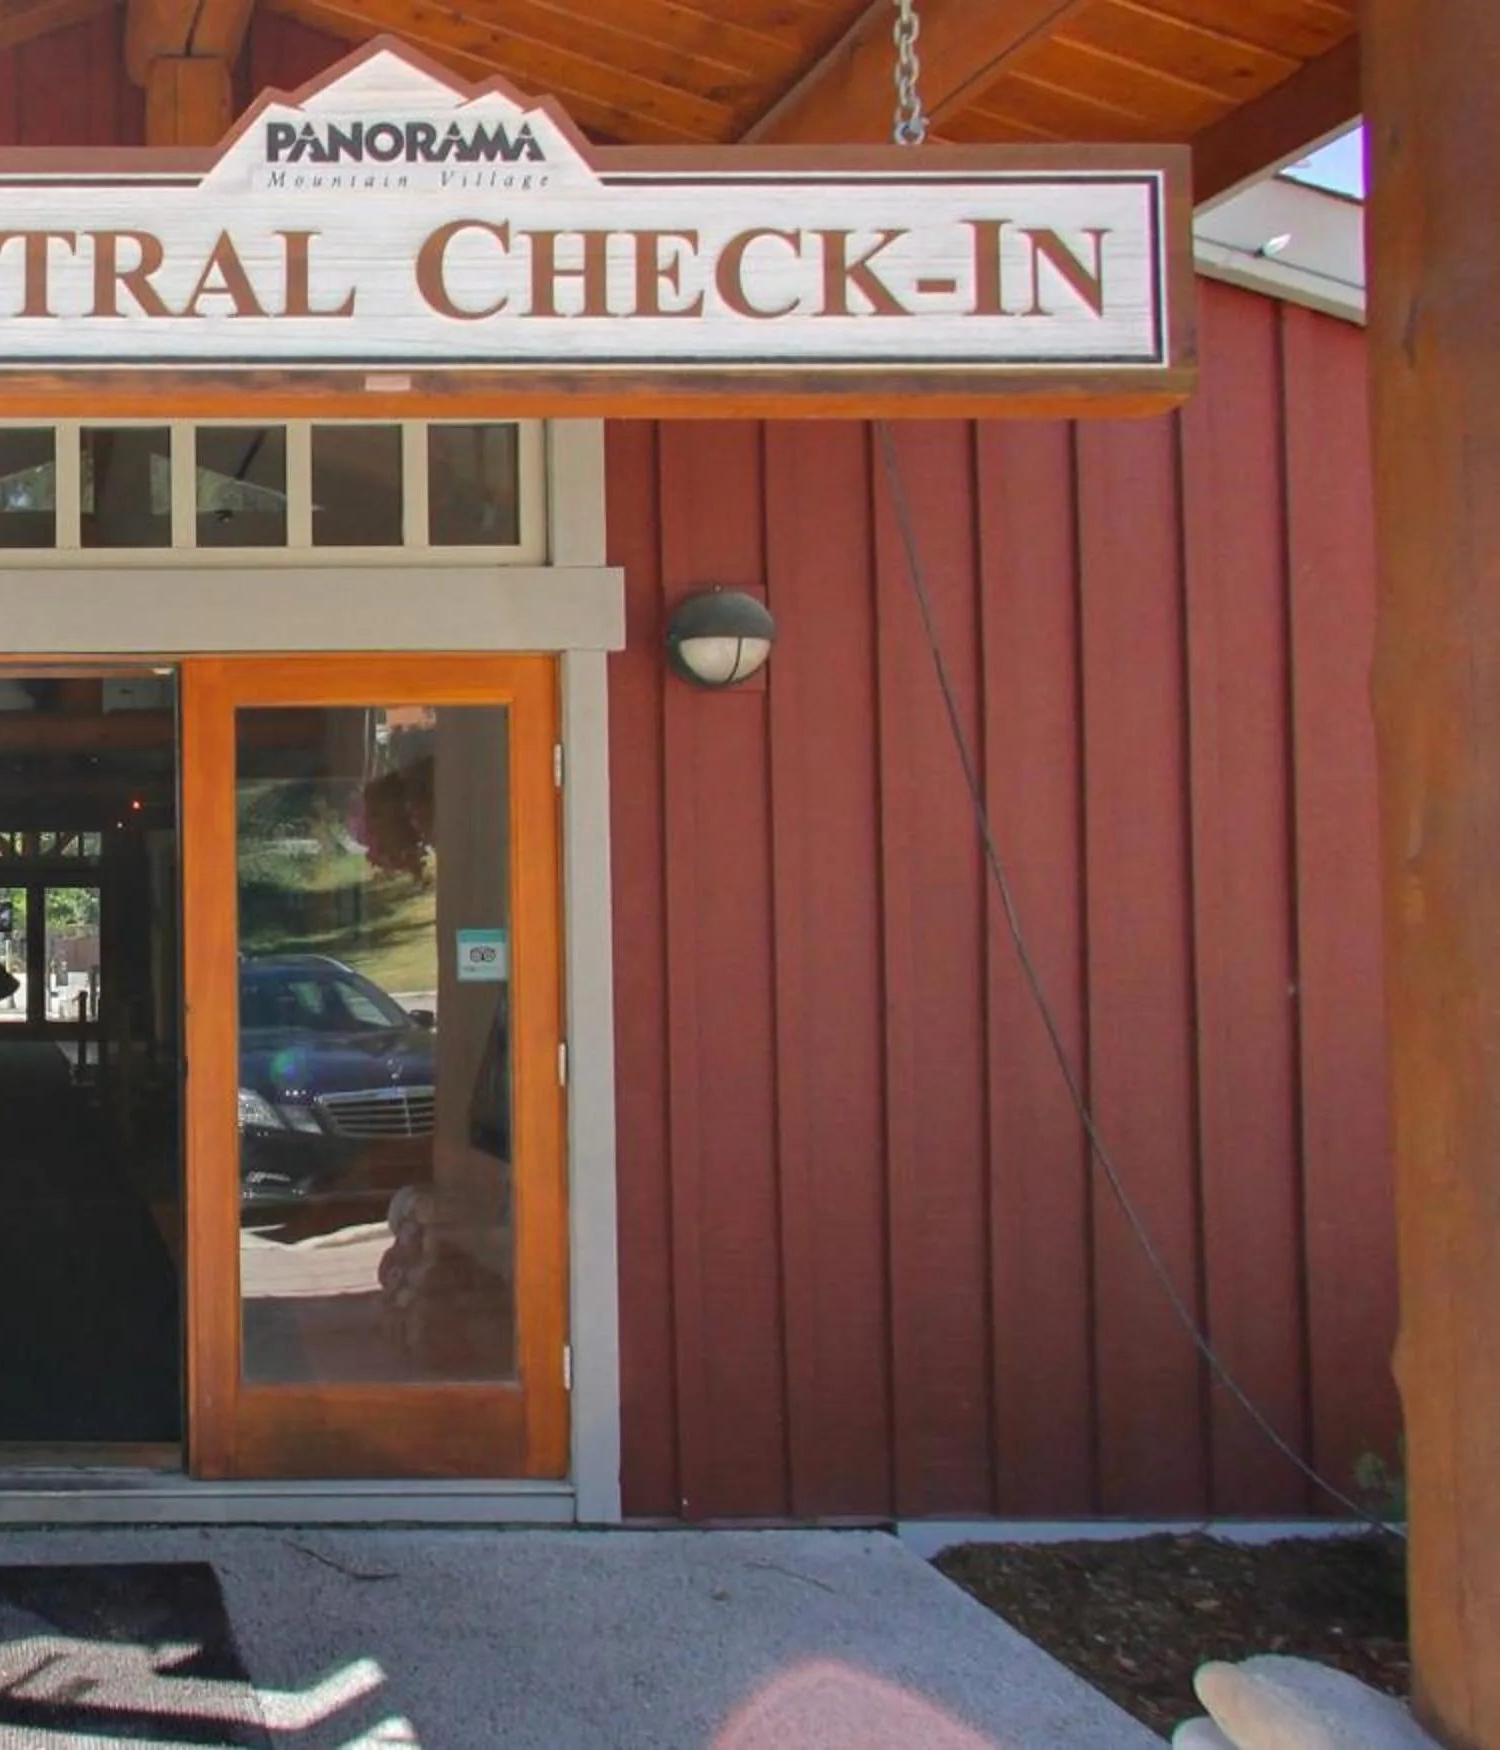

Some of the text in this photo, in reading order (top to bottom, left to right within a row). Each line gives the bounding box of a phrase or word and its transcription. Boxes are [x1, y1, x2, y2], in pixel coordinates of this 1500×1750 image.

[265, 121, 547, 163] PANORAMA
[267, 171, 551, 189] Mountain Village
[414, 217, 1112, 320] CHECK-IN
